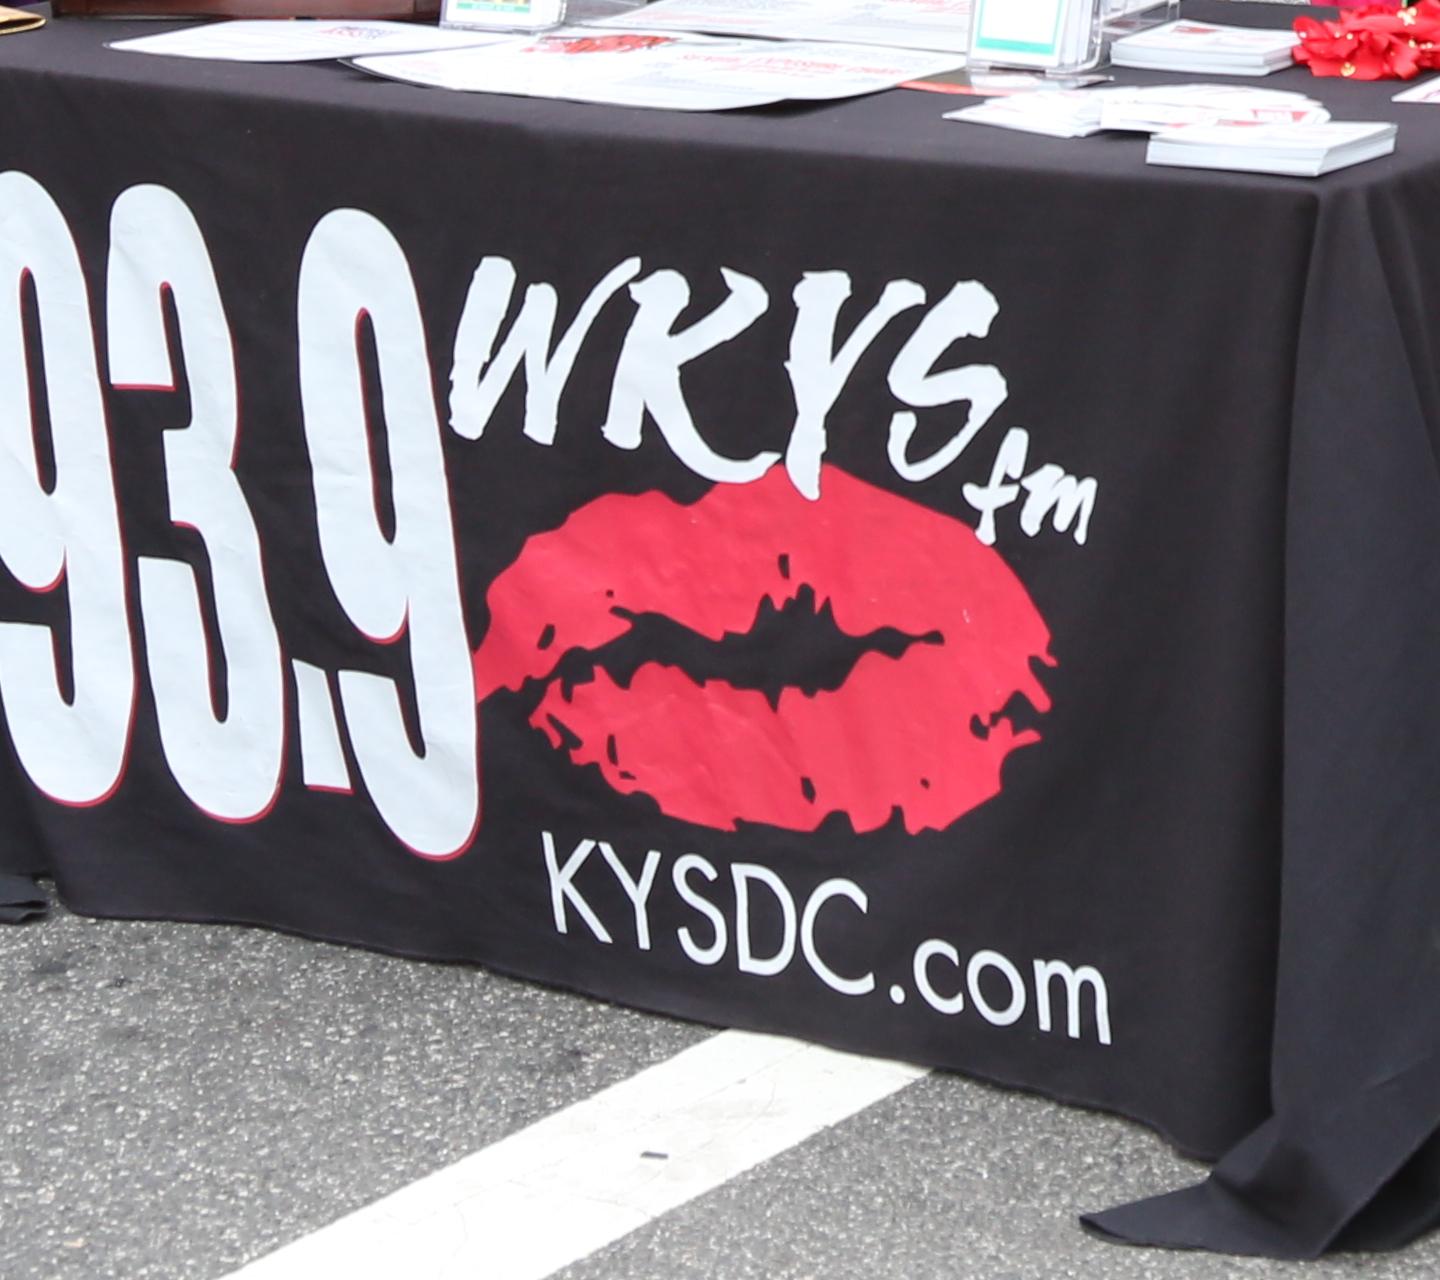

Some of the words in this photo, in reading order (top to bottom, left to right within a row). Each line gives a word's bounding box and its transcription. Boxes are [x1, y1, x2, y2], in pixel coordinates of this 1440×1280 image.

[448, 255, 1010, 501] WKYS
[963, 428, 1098, 546] fm
[540, 831, 1113, 1045] KYSDC.com
